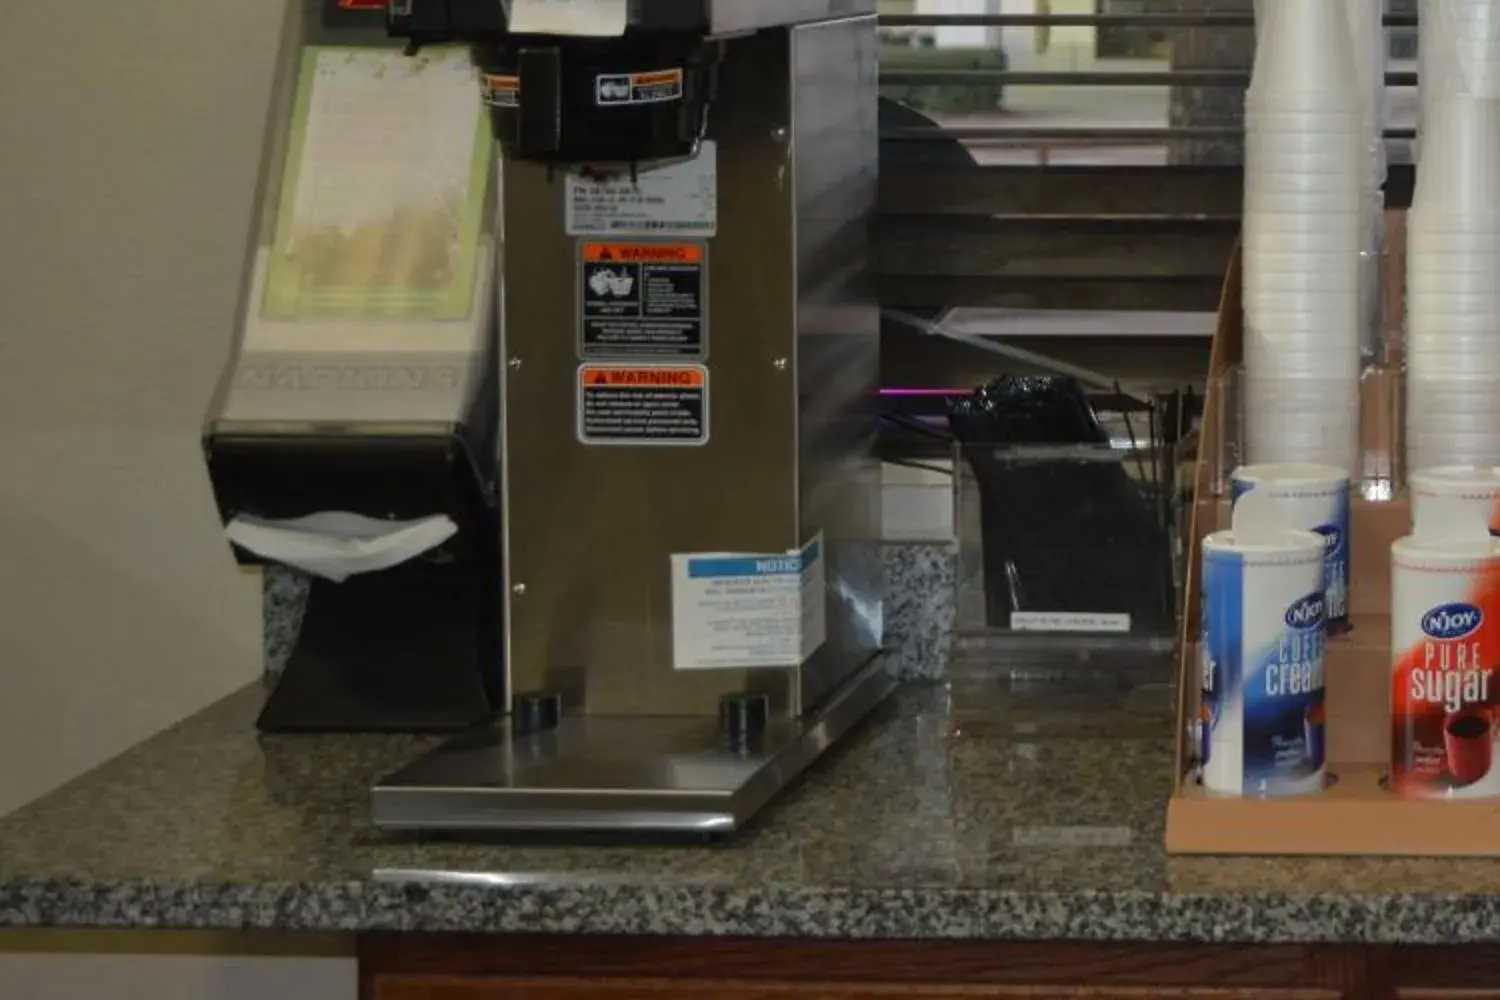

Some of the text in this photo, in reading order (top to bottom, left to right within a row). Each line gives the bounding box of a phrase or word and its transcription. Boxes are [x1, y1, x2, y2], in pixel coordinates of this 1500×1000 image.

[619, 247, 686, 260] WARNING
[611, 370, 692, 385] WARNING
[1424, 641, 1481, 670] PURE
[1265, 662, 1312, 696] crea
[1410, 667, 1493, 713] sugar
